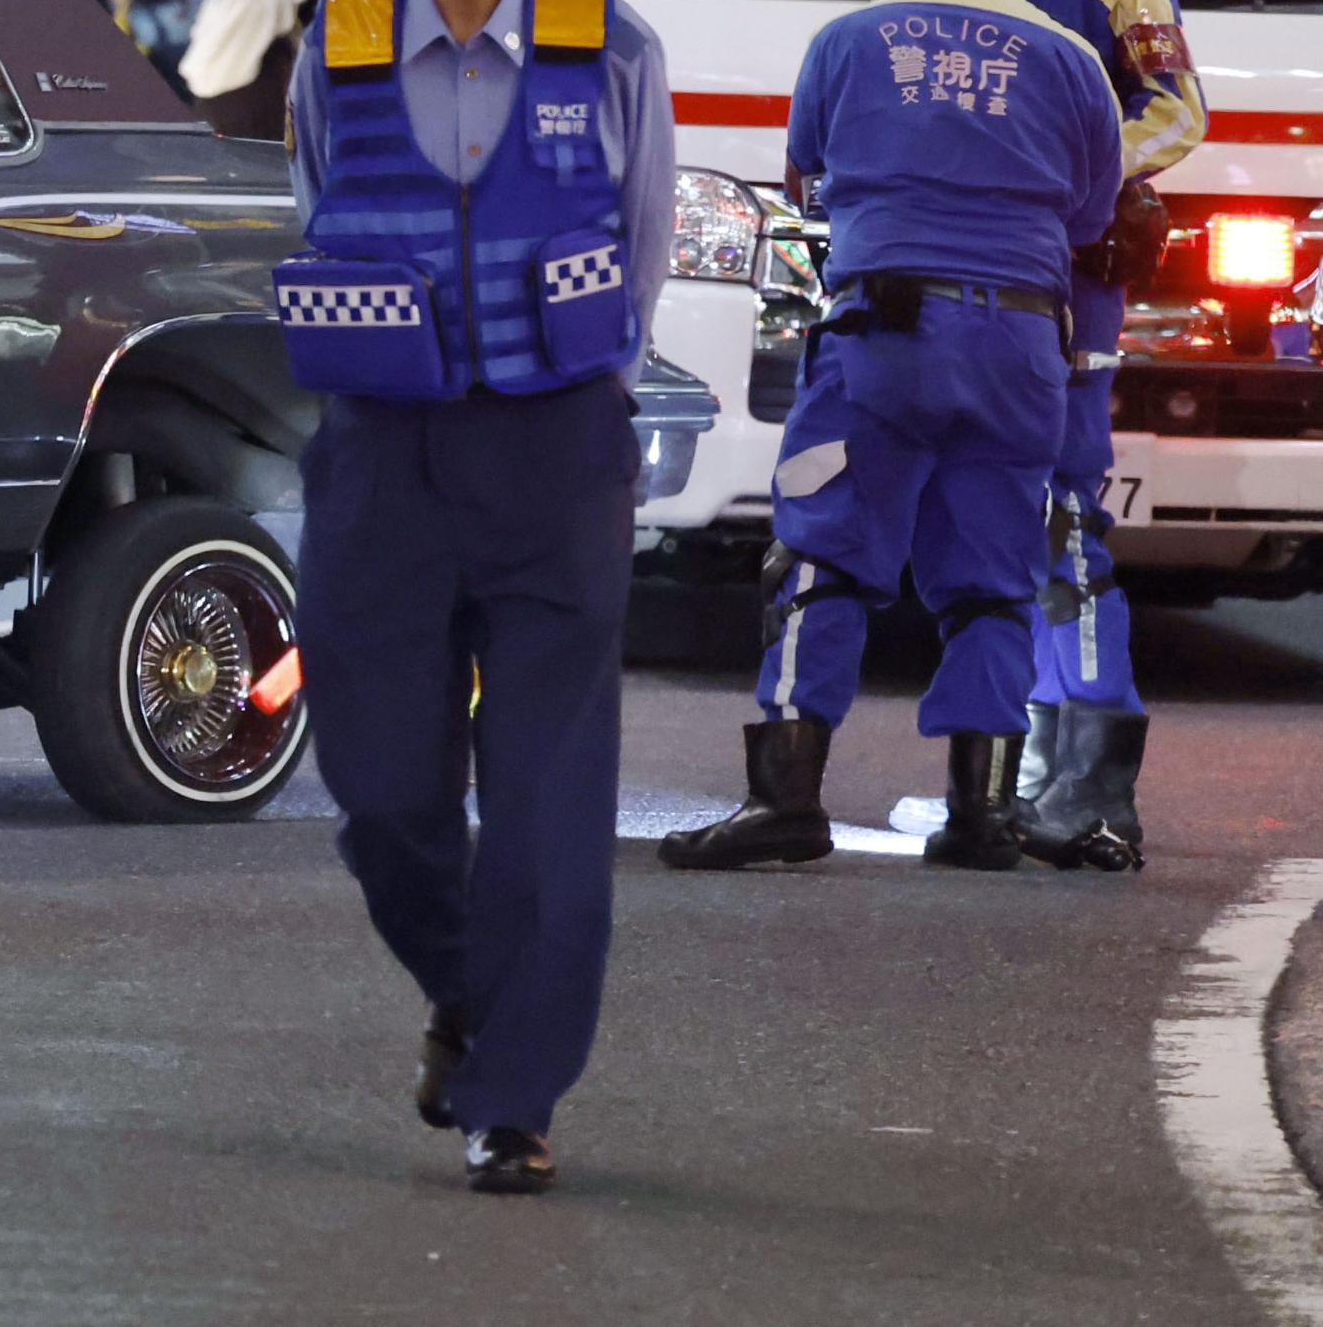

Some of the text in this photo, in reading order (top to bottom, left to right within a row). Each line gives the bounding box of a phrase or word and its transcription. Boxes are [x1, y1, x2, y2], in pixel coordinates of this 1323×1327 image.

[879, 17, 1027, 60] POLICE
[889, 45, 1018, 95] 警視庁
[537, 103, 588, 119] POLICE
